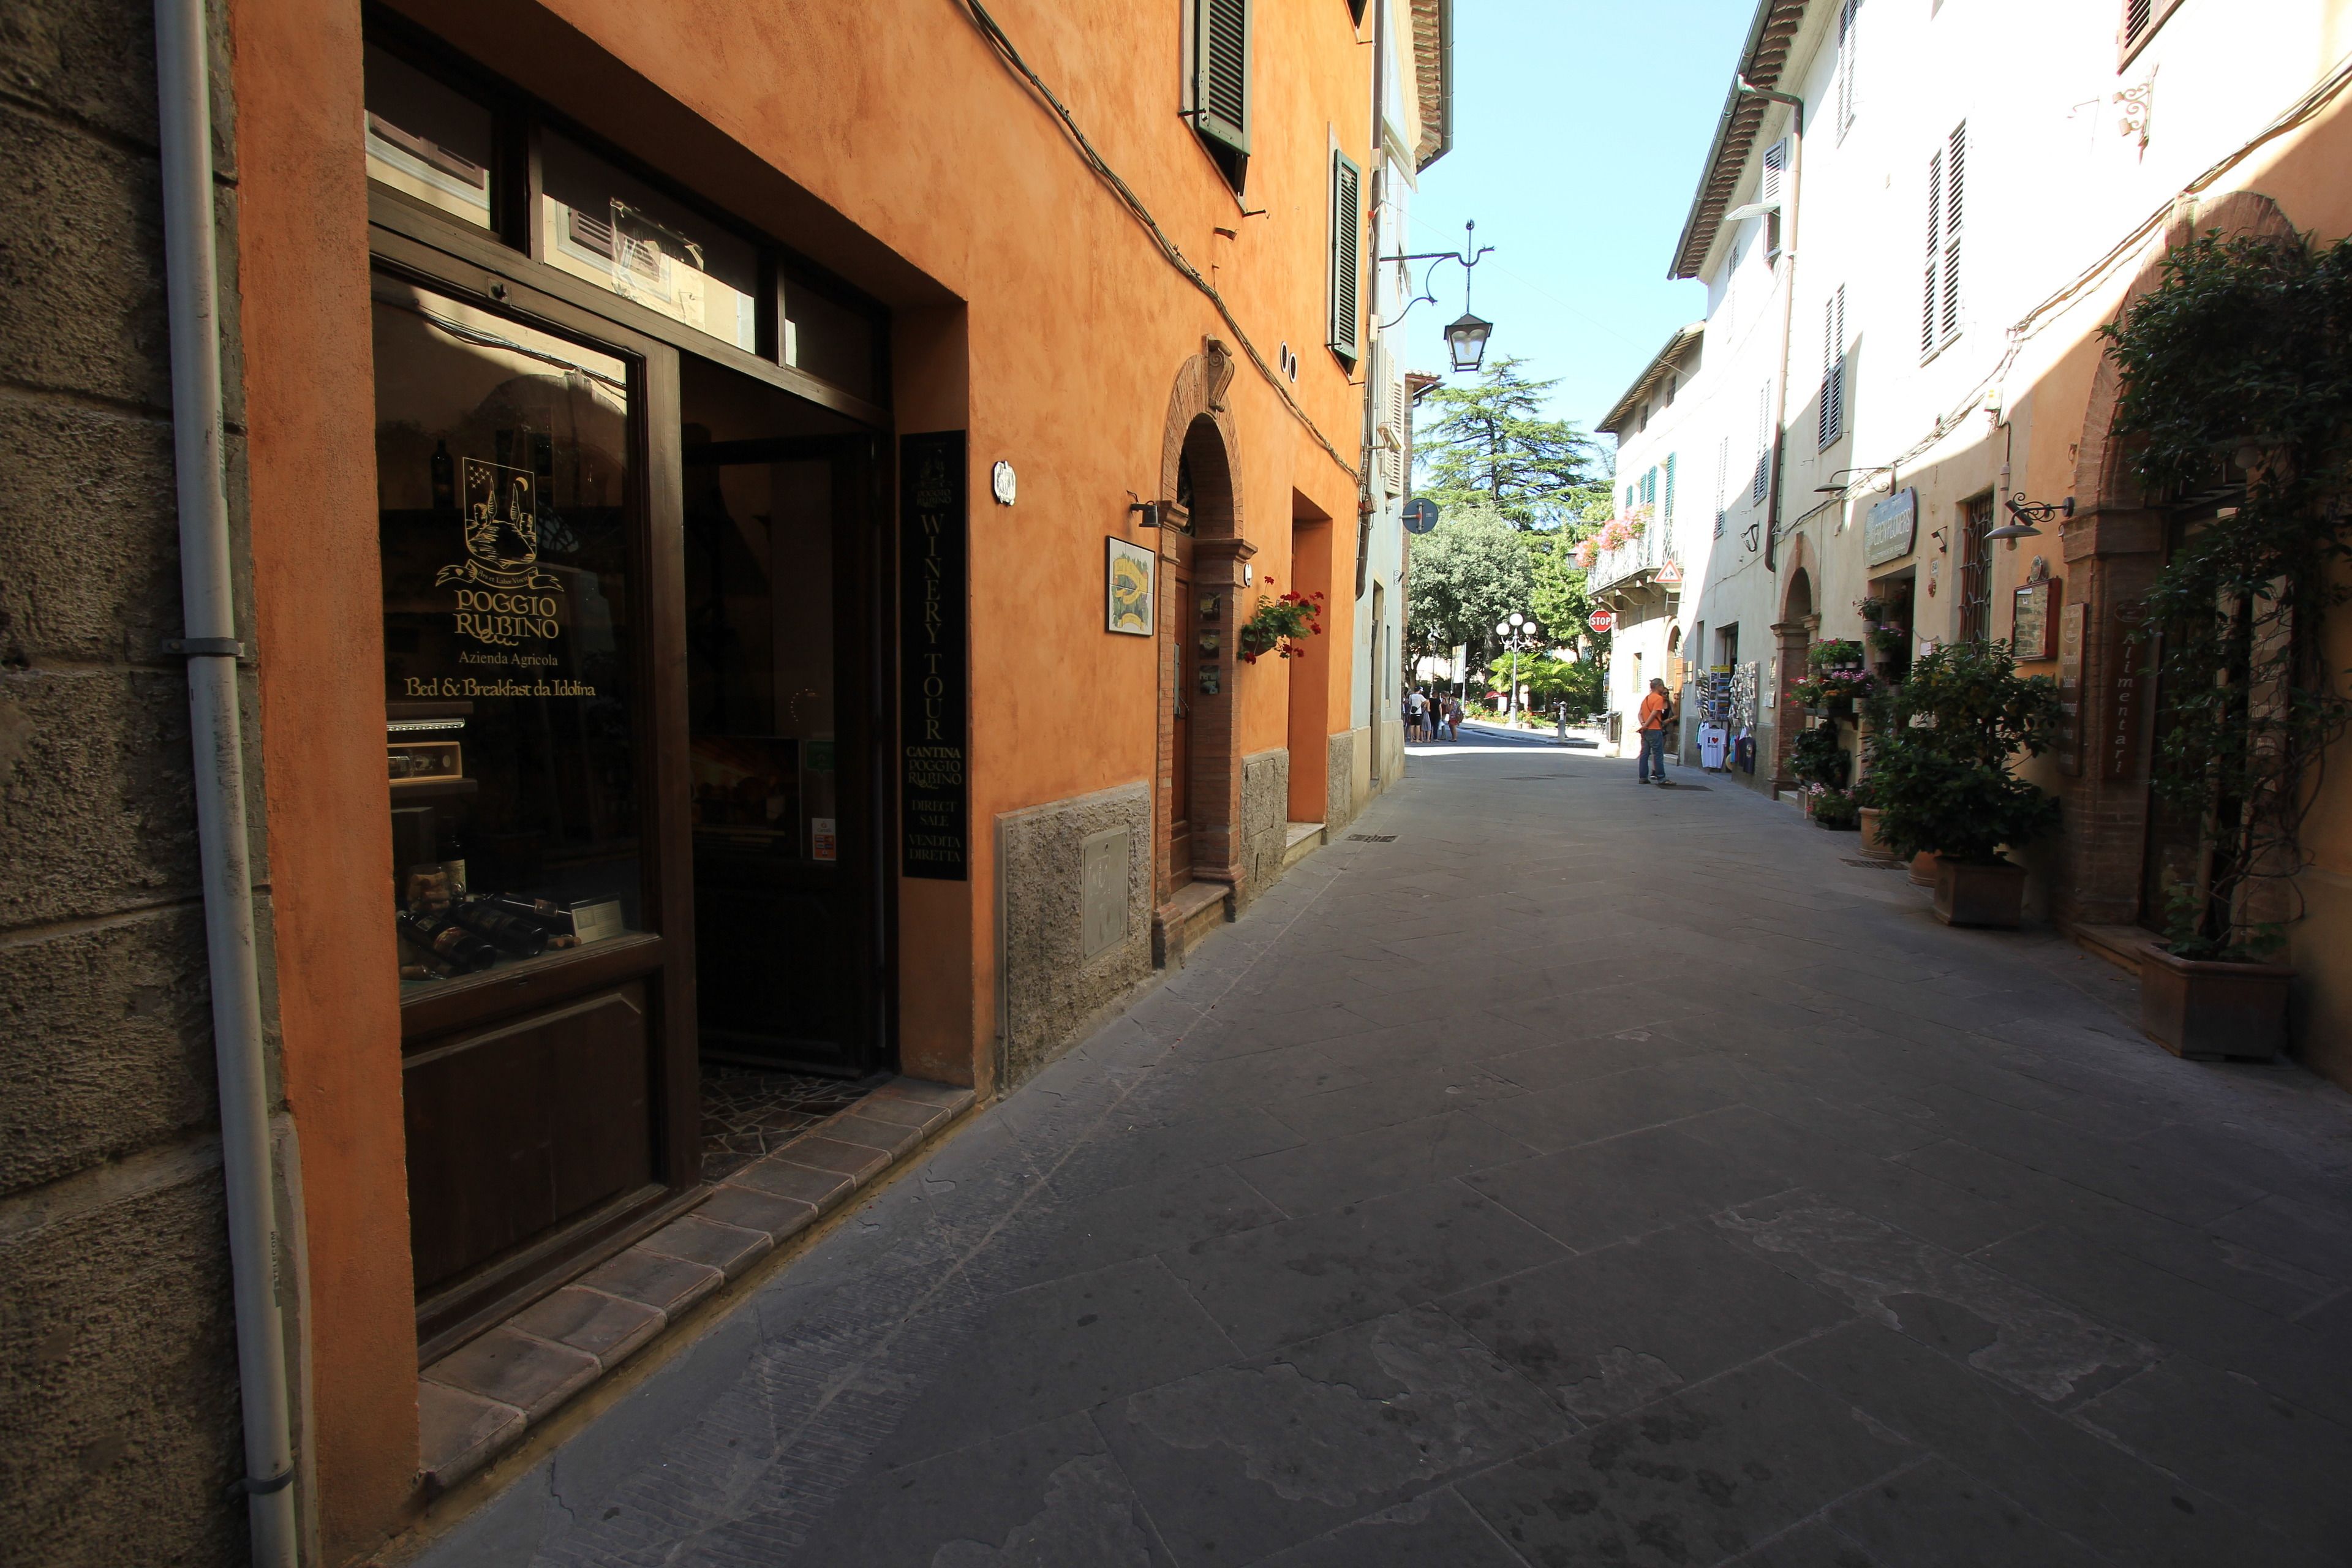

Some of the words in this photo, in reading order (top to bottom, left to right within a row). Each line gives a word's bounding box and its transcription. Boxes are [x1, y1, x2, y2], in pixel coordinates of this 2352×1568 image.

[921, 513, 945, 644] WINERY
[454, 589, 556, 617] POGGIO
[453, 612, 559, 646] RUBINO
[1591, 617, 1611, 625] STOP
[459, 650, 508, 665] Azienda
[511, 653, 559, 669] Agricola
[405, 677, 438, 696] Bed
[442, 678, 461, 696] &
[461, 678, 532, 697] Breakfast
[534, 680, 551, 696] da
[552, 679, 597, 696] Idolina
[923, 654, 944, 741] TOUR
[2115, 633, 2136, 772] Alimentari
[906, 746, 962, 759] CANTINA
[908, 759, 961, 772] POGGIO
[908, 771, 962, 789] RUBINO
[912, 799, 957, 813] DIRECT
[920, 815, 949, 827] SALE
[908, 834, 961, 848] VENDITA
[909, 848, 961, 862] DIRETTA
